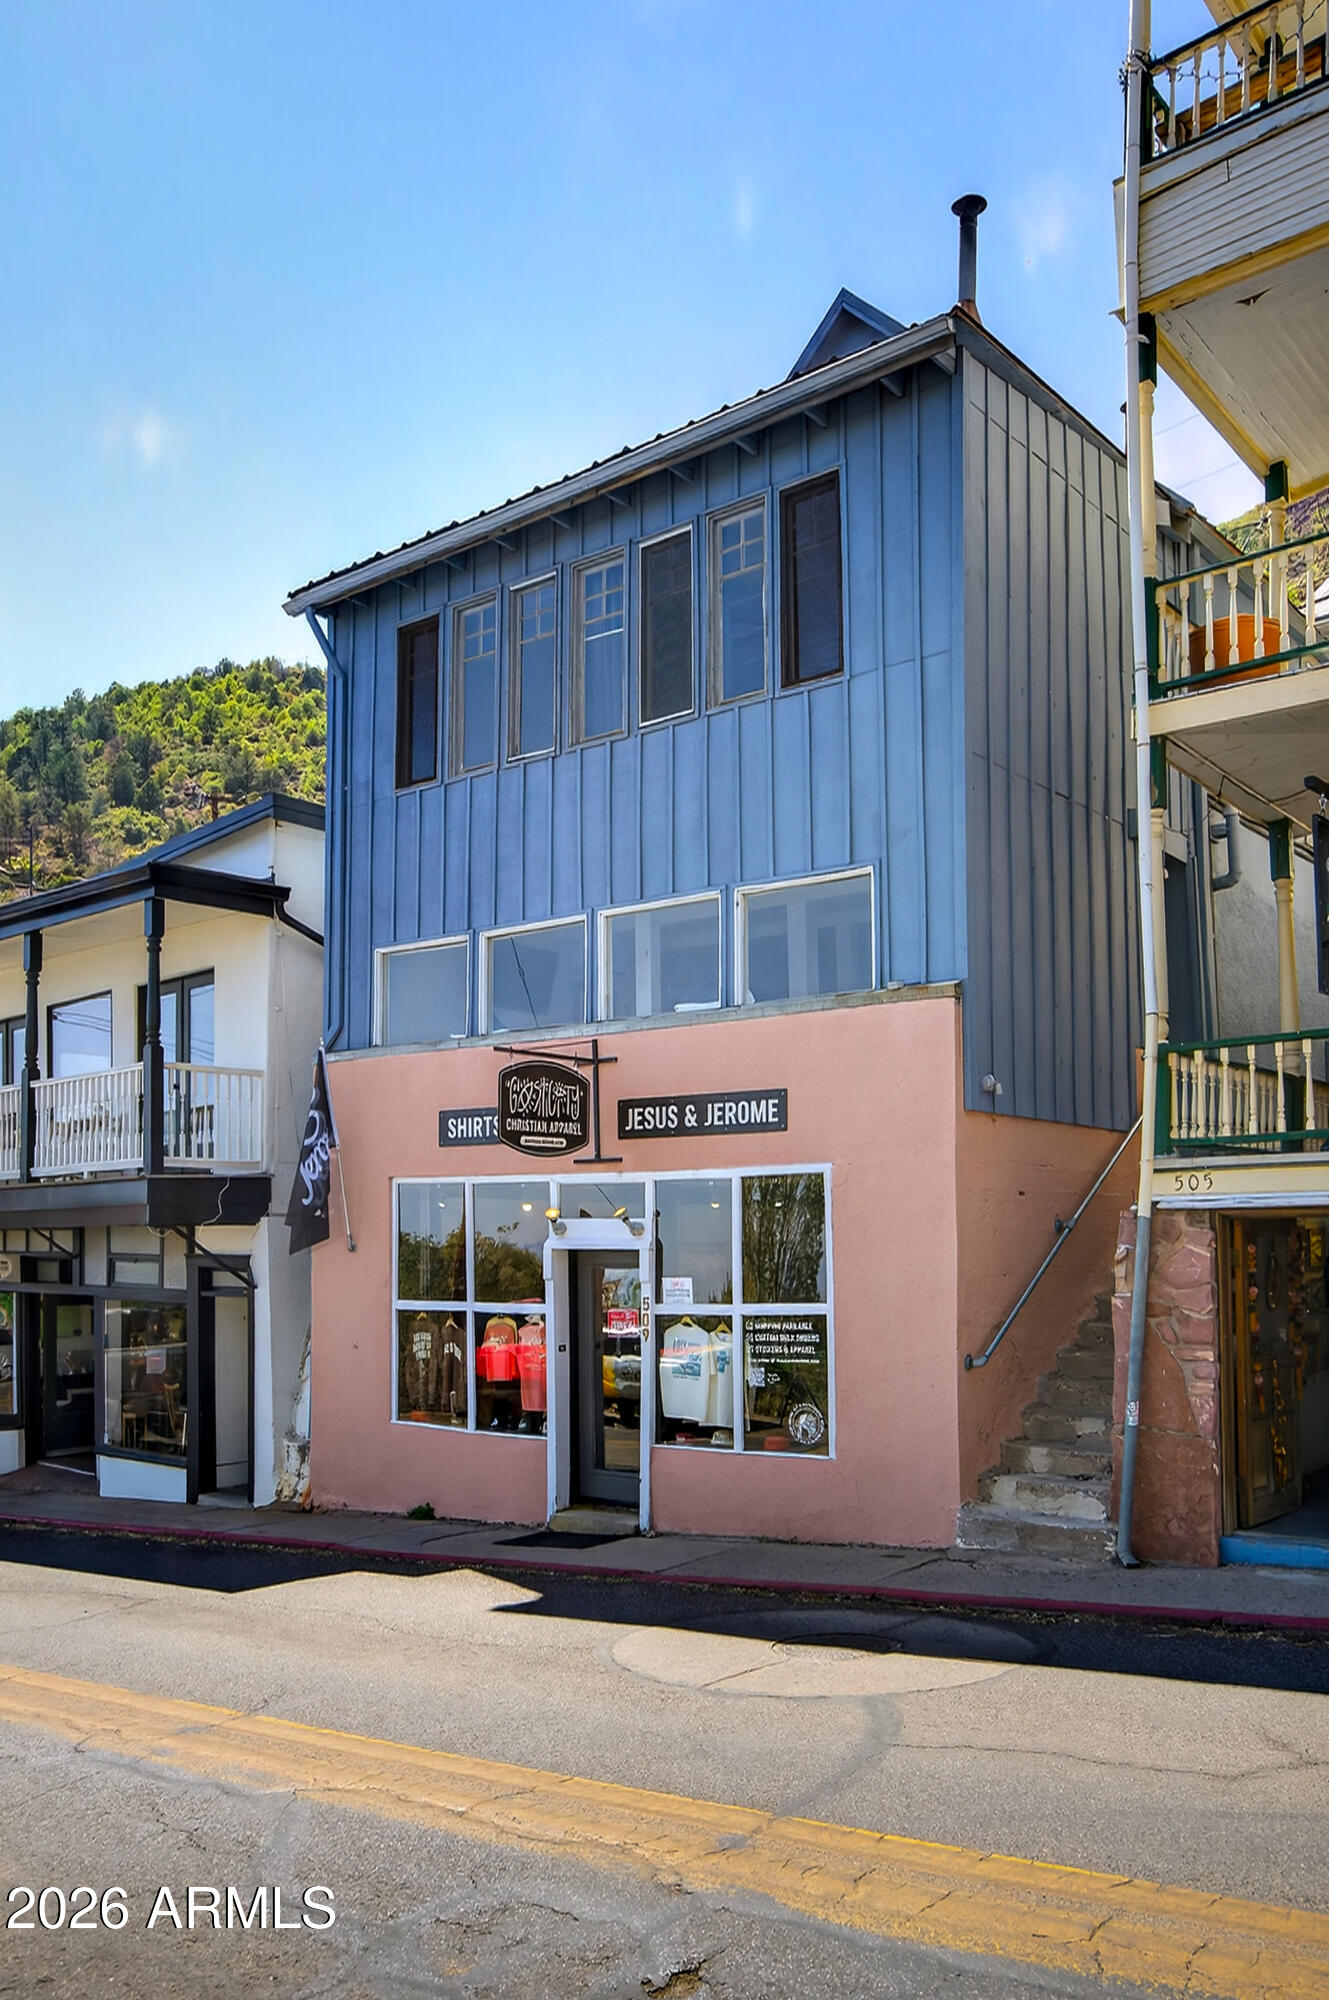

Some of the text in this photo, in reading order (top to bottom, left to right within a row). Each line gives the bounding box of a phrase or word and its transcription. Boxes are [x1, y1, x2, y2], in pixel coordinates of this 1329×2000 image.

[506, 1117, 547, 1134] CHRISTIAN
[625, 1098, 779, 1131] JESUS & JEROME
[1174, 1172, 1214, 1192] 505
[642, 1296, 650, 1342] 509
